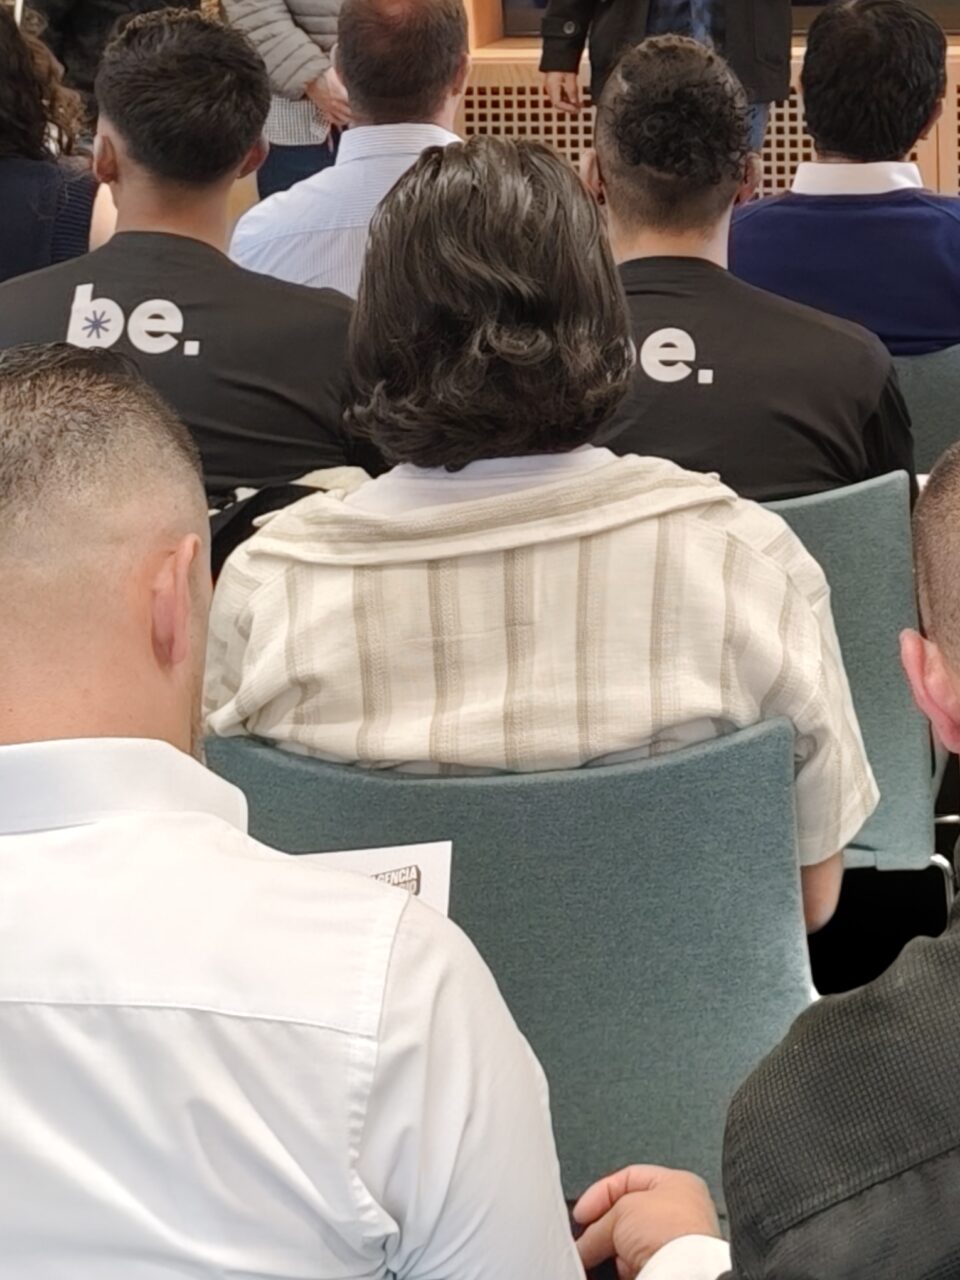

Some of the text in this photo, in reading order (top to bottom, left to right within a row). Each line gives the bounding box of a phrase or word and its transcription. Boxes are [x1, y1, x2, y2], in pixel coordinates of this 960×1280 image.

[66, 283, 199, 356] be.
[629, 327, 713, 384] e.
[374, 865, 417, 885] GENCIA
